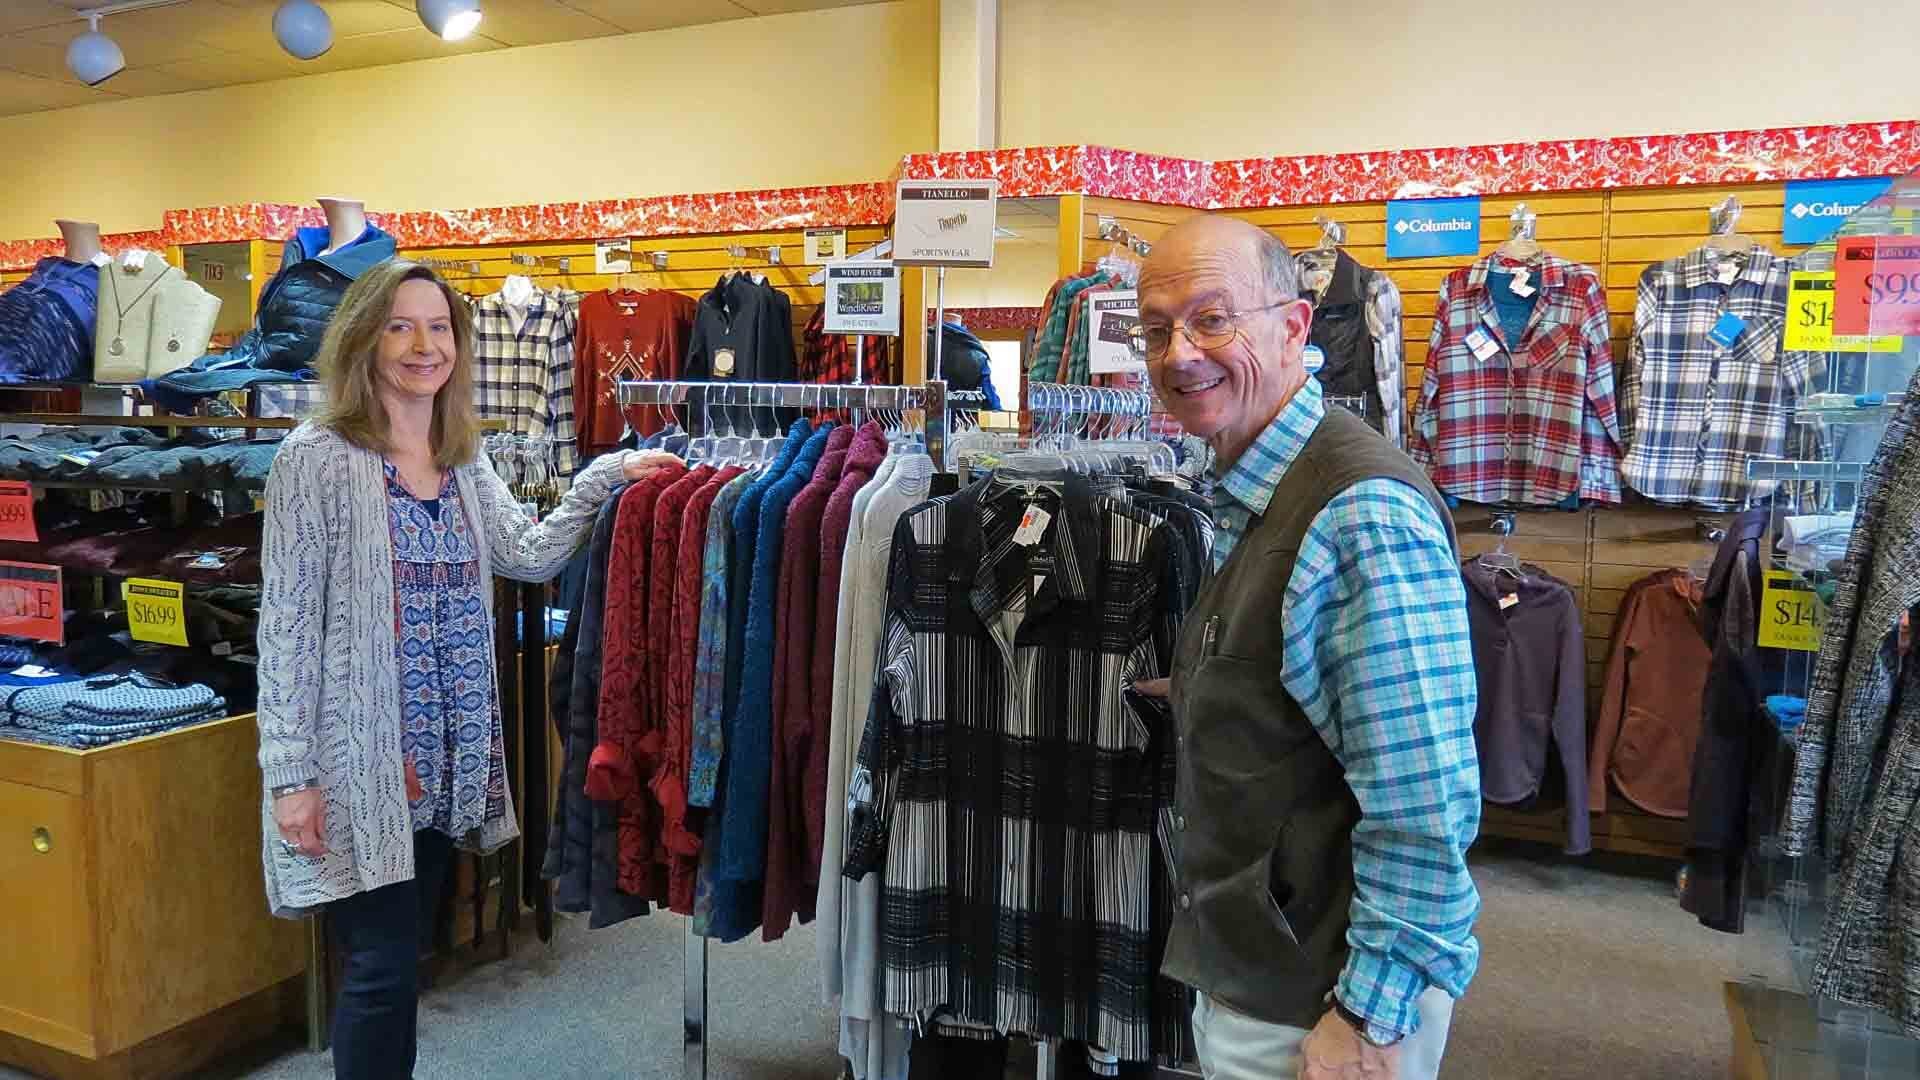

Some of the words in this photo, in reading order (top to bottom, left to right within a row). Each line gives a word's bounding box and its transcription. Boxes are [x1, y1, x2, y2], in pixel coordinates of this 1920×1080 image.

[921, 190, 967, 199] TIANELLO
[1409, 219, 1472, 232] Columbia
[912, 248, 970, 257] SPORTSWEAR
[841, 269, 859, 277] WIND
[860, 268, 882, 277] RIVER
[134, 601, 176, 626] $16.99
